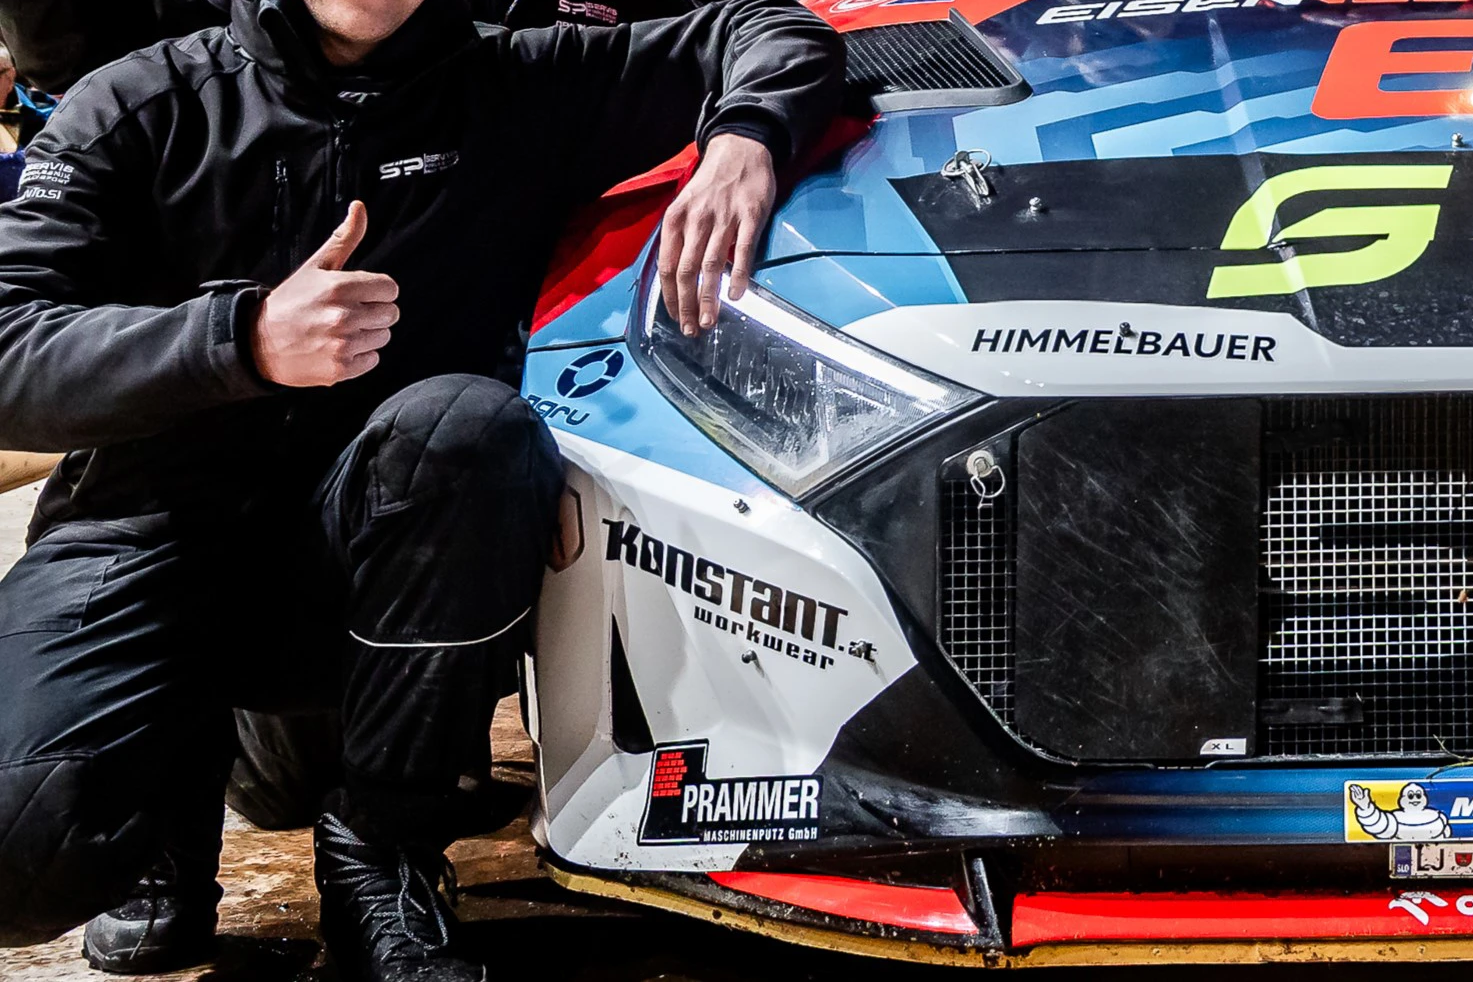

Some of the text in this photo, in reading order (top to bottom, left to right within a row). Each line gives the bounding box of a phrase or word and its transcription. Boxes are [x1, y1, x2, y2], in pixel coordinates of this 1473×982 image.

[971, 328, 1278, 362] HIMMELBAUER
[694, 606, 835, 670] workwear
[681, 779, 820, 823] PRAMMER
[703, 826, 818, 842] MASCHINENPUTZ GmbH
[1417, 847, 1445, 872] LJ
